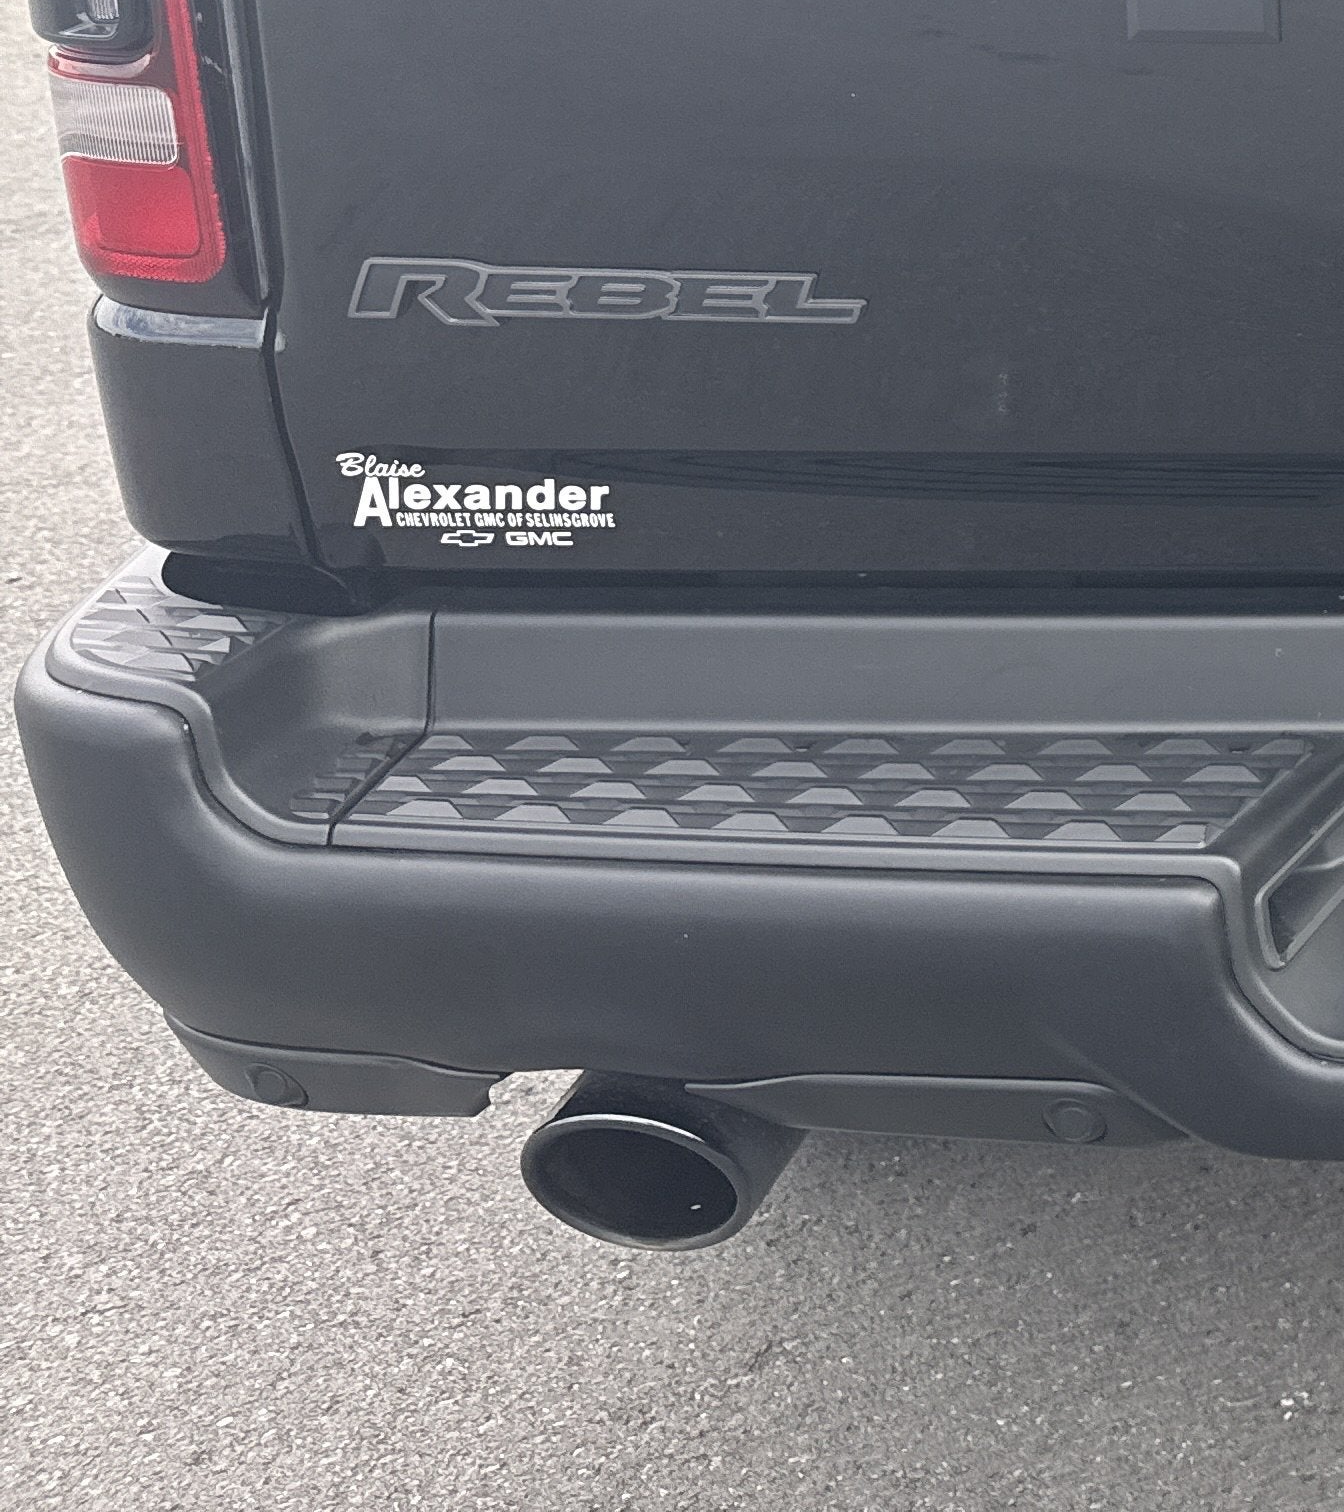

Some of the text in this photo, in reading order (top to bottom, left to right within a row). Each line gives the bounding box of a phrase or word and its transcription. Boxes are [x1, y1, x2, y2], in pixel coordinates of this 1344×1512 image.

[347, 256, 868, 327] REBEL
[335, 452, 425, 478] Blaise
[353, 476, 610, 527] Alexander
[396, 512, 616, 528] CHEVROLET GMC OF SELINSGROVE
[505, 531, 574, 546] GMC
